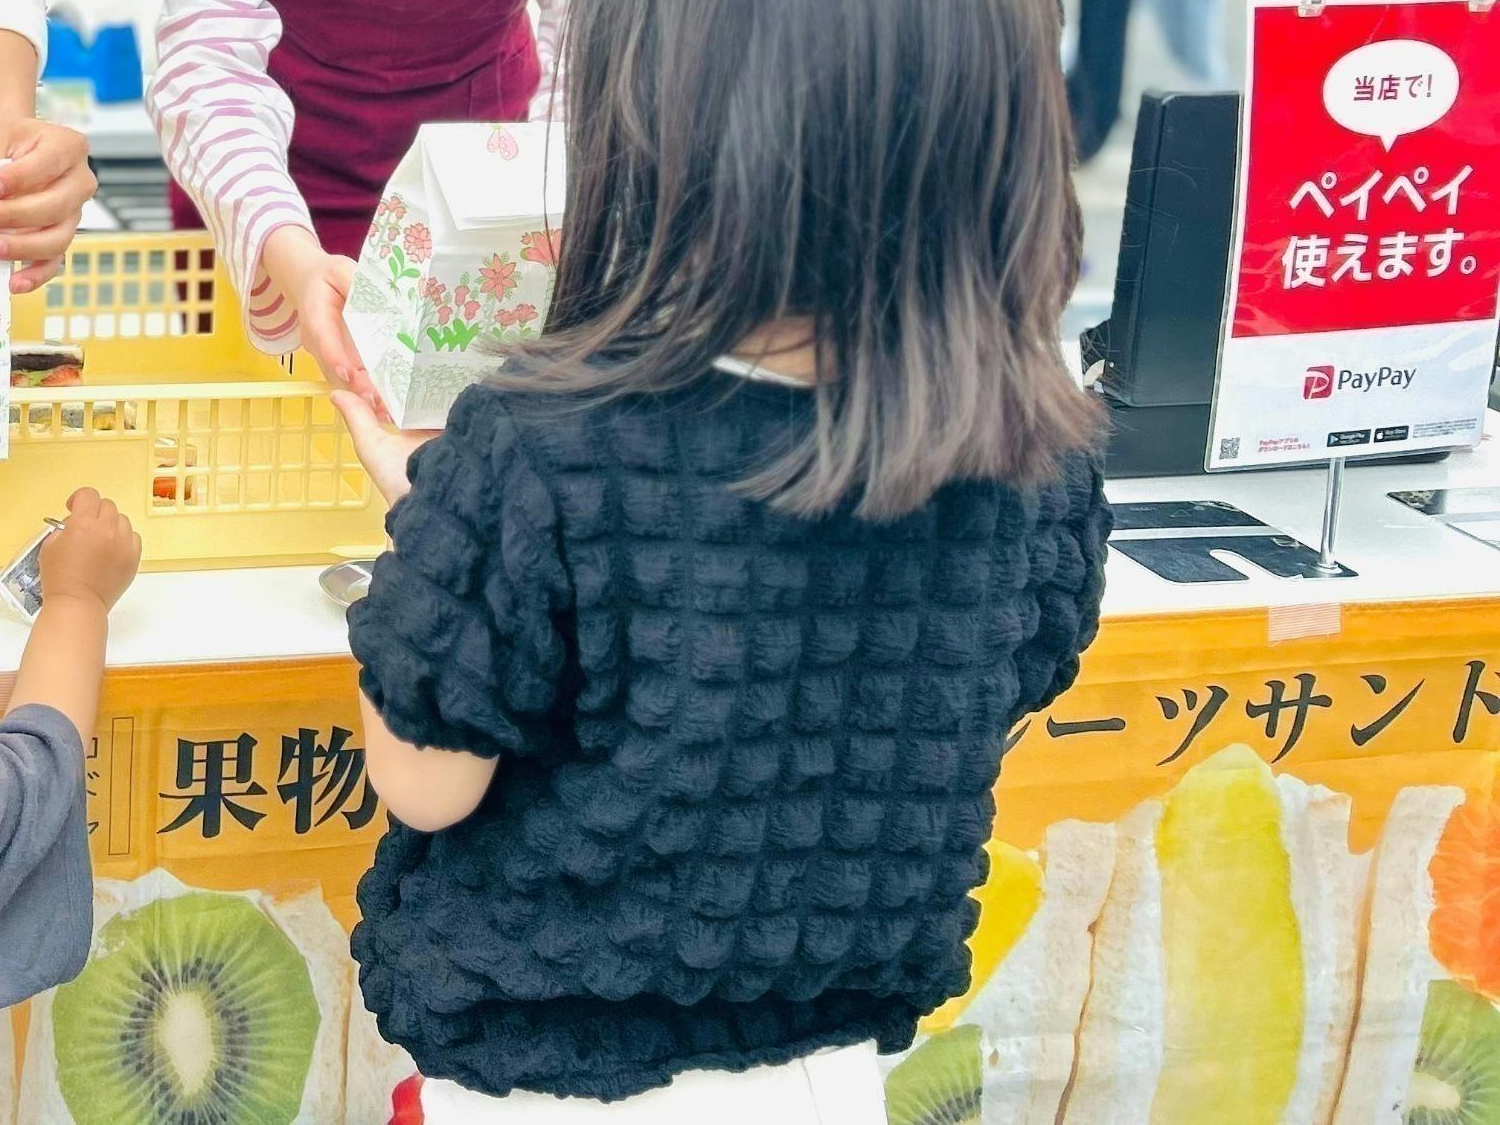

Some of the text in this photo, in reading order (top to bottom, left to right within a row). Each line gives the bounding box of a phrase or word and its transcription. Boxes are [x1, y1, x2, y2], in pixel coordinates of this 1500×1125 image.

[1353, 73, 1433, 102] 当店で!
[1289, 164, 1474, 221] ペイペイ
[1281, 227, 1478, 290] 使えます。
[1337, 366, 1417, 393] PayPay
[156, 725, 380, 839] 果物
[1002, 660, 1500, 767] ーツサンド
